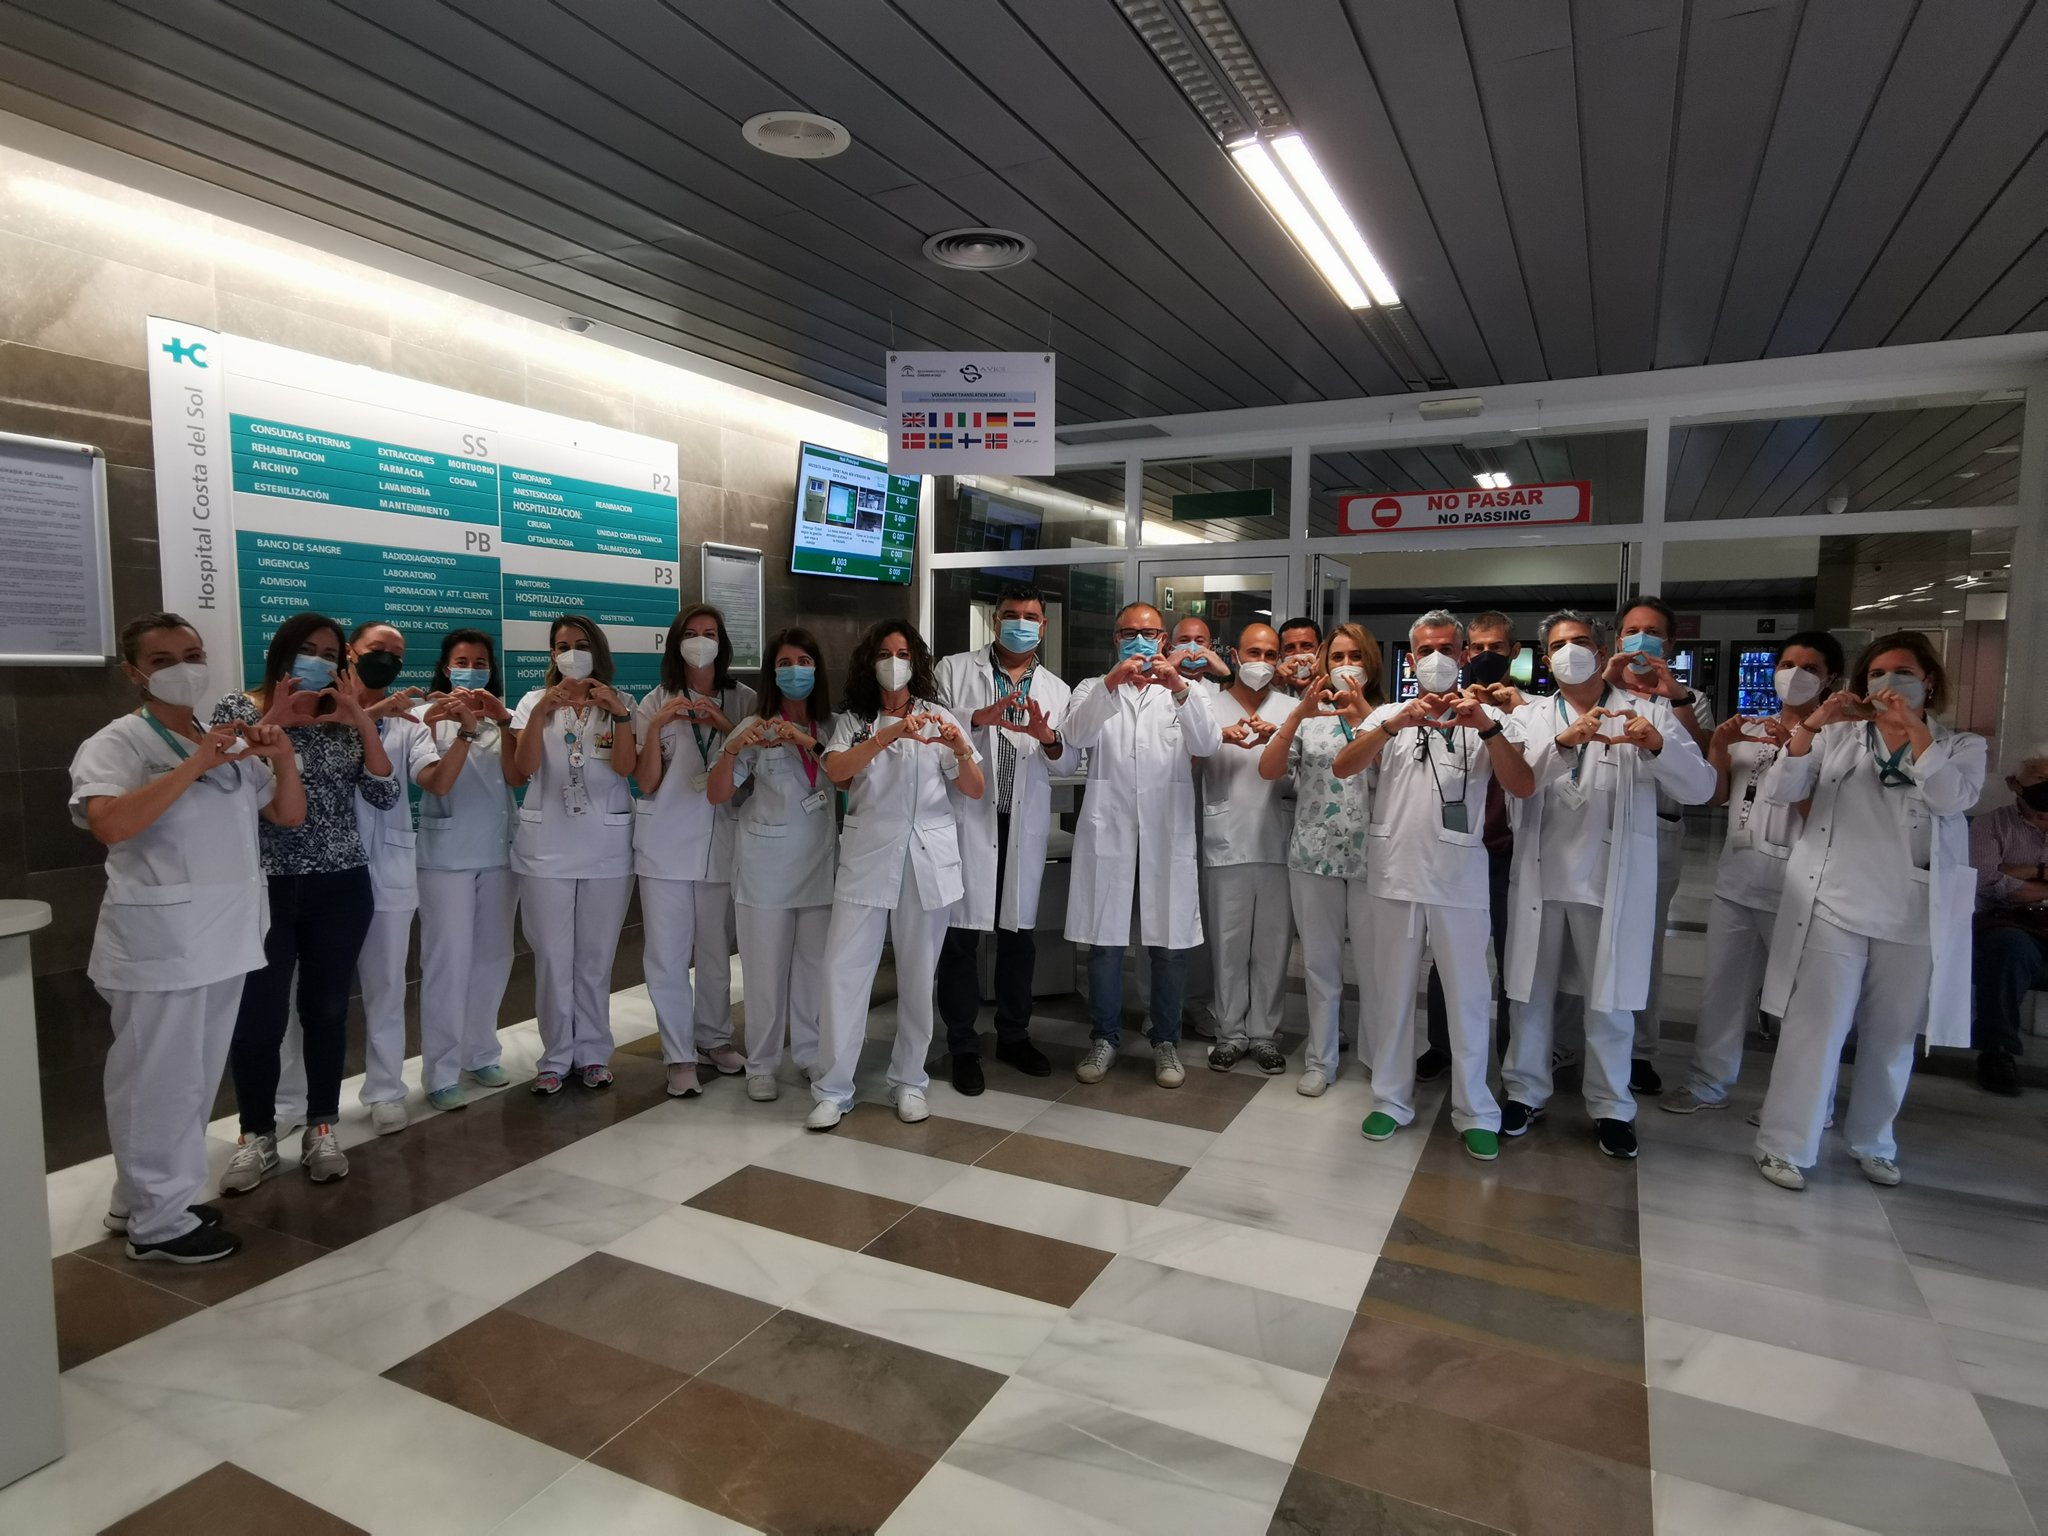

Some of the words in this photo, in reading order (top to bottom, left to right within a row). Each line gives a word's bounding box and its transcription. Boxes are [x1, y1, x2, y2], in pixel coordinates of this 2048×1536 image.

[184, 386, 205, 419] Sol
[187, 425, 207, 457] del
[250, 423, 304, 442] CONSULTAS
[306, 434, 351, 450] EXTERNAS
[251, 442, 325, 463] REHABILITACION
[462, 434, 489, 458] SS
[377, 447, 435, 466] EXTRACCIONES
[252, 460, 299, 476] ARCHIVO
[379, 463, 424, 479] FARMACIA
[447, 459, 495, 476] MORTUORIO
[449, 476, 478, 488] COCINA
[512, 471, 552, 486] QUIROFANOS
[652, 473, 672, 493] P2
[192, 463, 210, 521] Costa
[254, 482, 330, 502] ESTERILIZACIÓN
[512, 487, 564, 503] ANESTESIOLOGIA
[1428, 494, 1460, 511] NO
[1468, 489, 1544, 509] PASAR
[379, 499, 450, 517] MANTENIMIENTO
[513, 501, 583, 520] HOSPITALIZACION:
[595, 500, 633, 514] REANIMACION
[527, 519, 552, 530] CIRUGIA
[1438, 512, 1460, 525] NO
[1464, 509, 1531, 524] PASSING
[465, 530, 492, 552] PB
[527, 535, 575, 548] OFTALMOLOGIA
[596, 528, 619, 539] UNIDAD
[619, 531, 638, 541] CORTA
[637, 534, 663, 544] ESTANCIA
[256, 538, 291, 551] BANCO
[292, 541, 305, 552] DE
[306, 542, 342, 556] SANGRE
[596, 543, 642, 556] TRAUMATOLOGIA
[258, 558, 310, 571] URGENCIAS
[382, 551, 457, 566] RADIODIAGNOSTICO
[831, 556, 836, 565] A
[836, 557, 847, 567] 003
[193, 527, 217, 610] Hospital
[383, 568, 437, 581] LABORATORIO
[654, 567, 673, 585] P3
[259, 576, 307, 588] ADMISION
[260, 594, 310, 607] CAFETERIA
[384, 585, 438, 598] INFORMACION
[438, 589, 445, 598] Y
[446, 589, 463, 599] ATT.
[463, 591, 490, 601] CLIENTE
[515, 592, 585, 607] HOSPITALIZACION:
[384, 602, 425, 614] DIRECCION
[425, 605, 432, 614] Y
[433, 605, 493, 617] ADMINISTRACION
[529, 609, 564, 618] NEONATOS
[260, 613, 287, 624] SALA
[412, 620, 424, 630] DE
[424, 620, 449, 631] ACTOS
[600, 613, 635, 623] OBSTETRICIA
[629, 683, 653, 691] INTERNA
